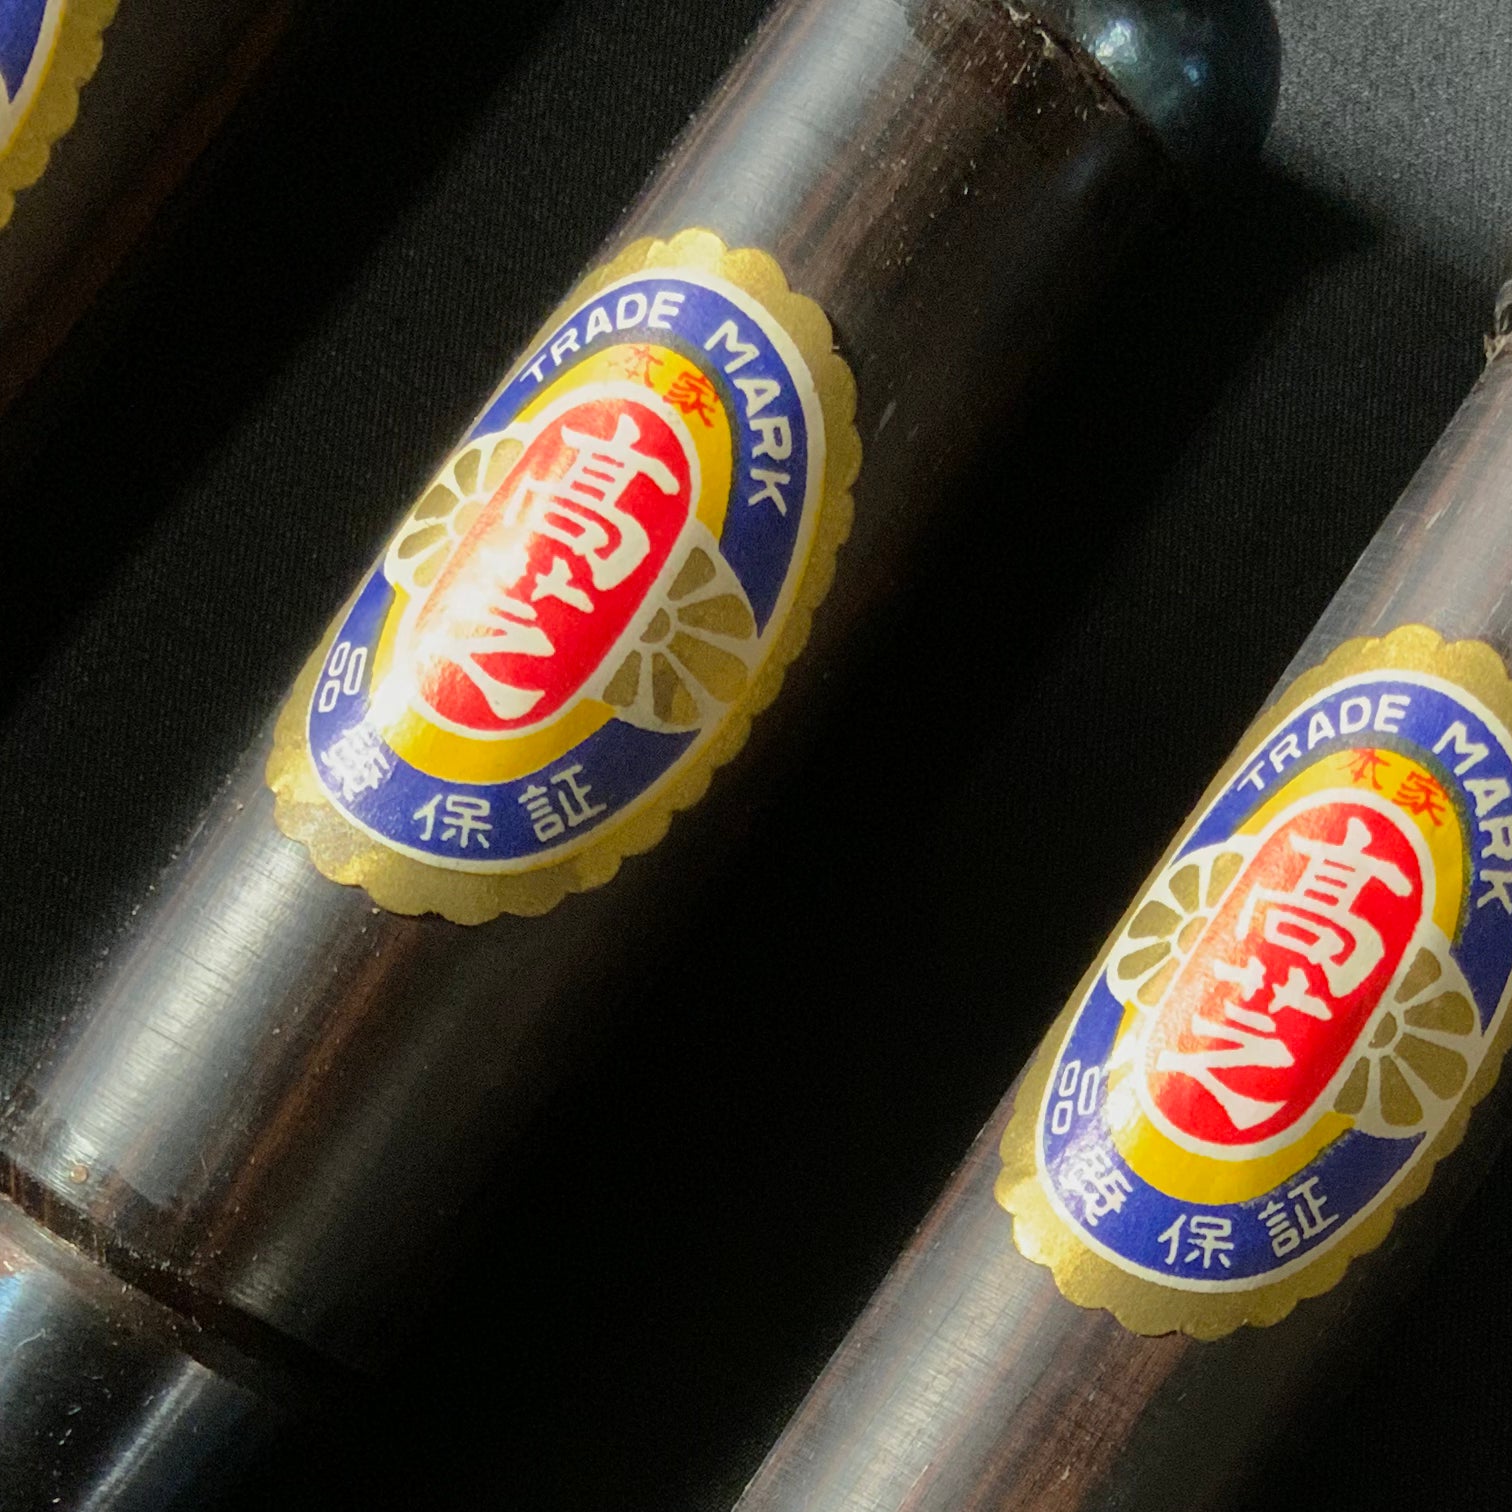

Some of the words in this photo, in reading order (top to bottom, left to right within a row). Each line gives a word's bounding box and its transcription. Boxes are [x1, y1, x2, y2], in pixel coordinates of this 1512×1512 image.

[519, 291, 685, 384] TRADE
[704, 320, 788, 516] MARK
[1237, 693, 1411, 791] TRADE
[1336, 747, 1448, 828] 本家
